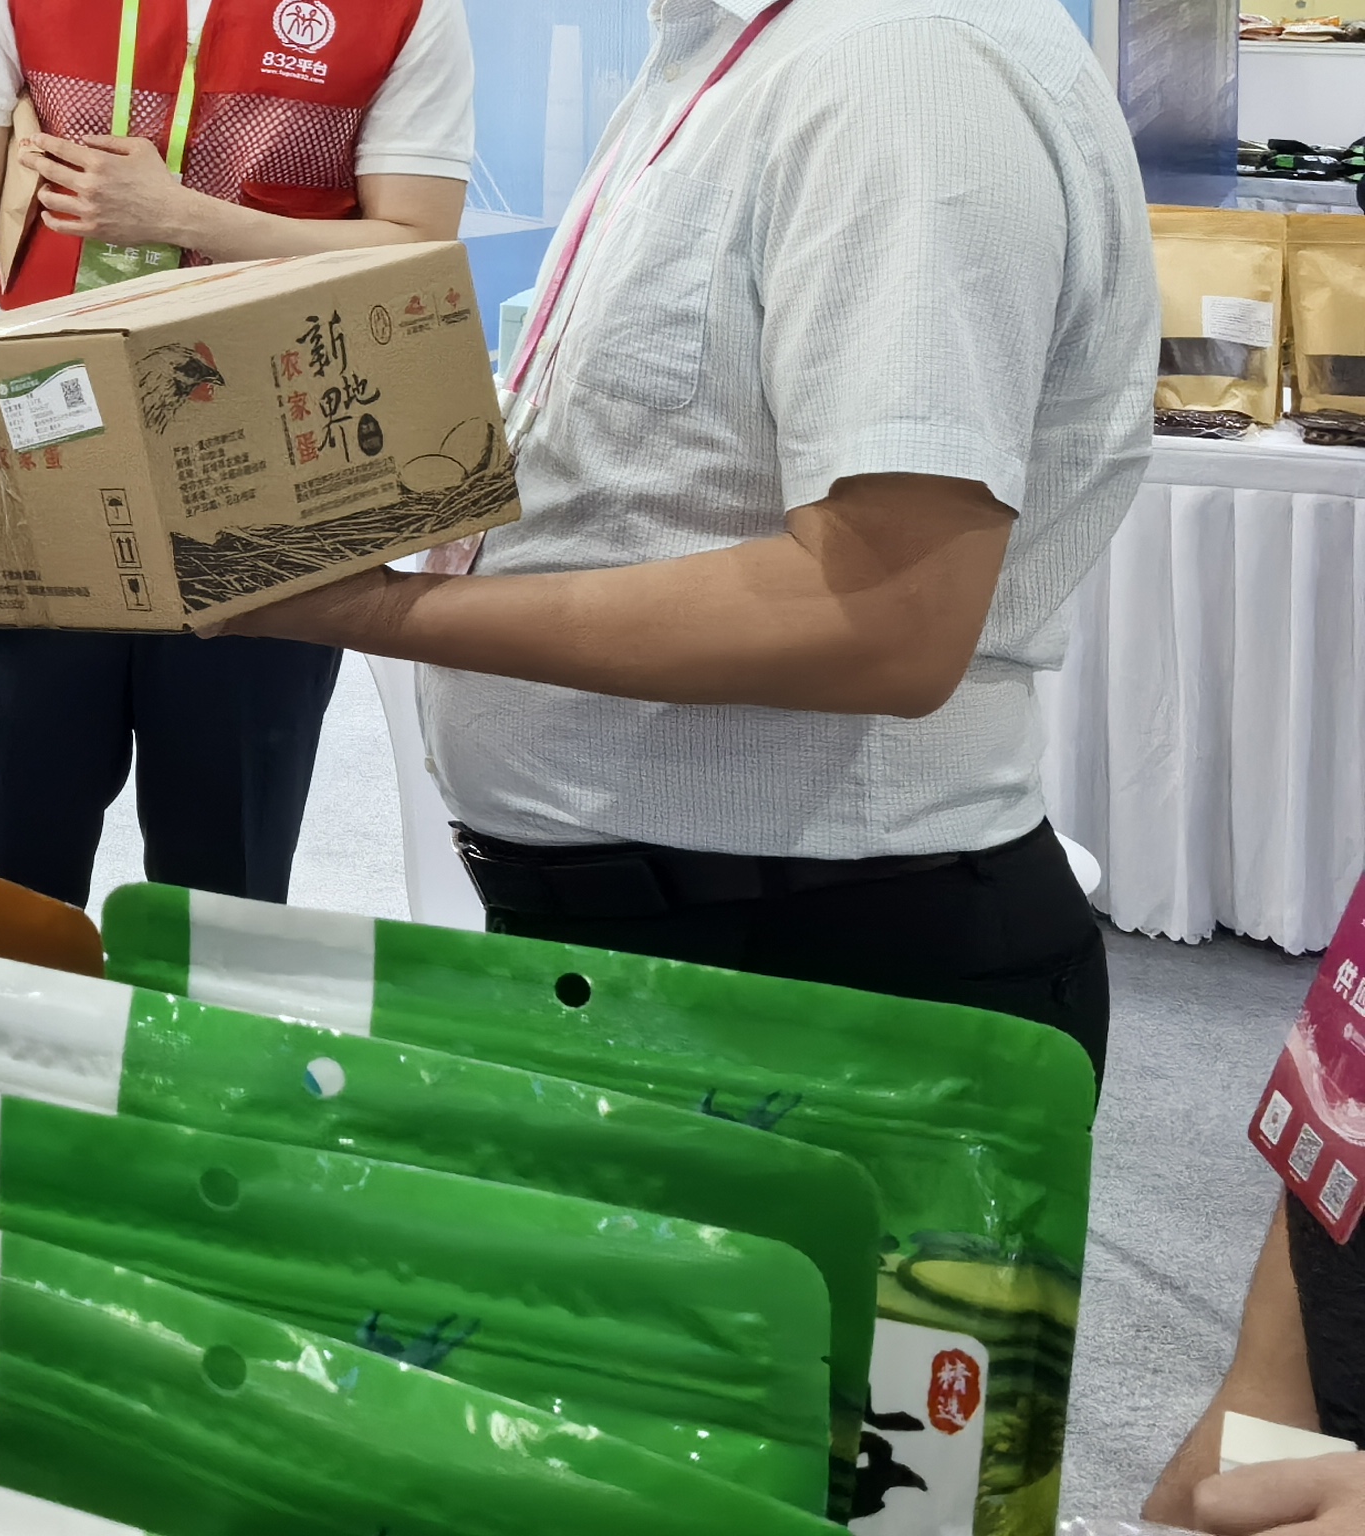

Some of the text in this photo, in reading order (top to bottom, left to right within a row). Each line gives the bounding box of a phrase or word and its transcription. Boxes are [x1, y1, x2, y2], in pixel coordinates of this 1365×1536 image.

[262, 51, 328, 76] 832平台
[102, 243, 162, 266] 工作证
[280, 350, 319, 465] 农家蛋
[296, 310, 381, 464] 新地界
